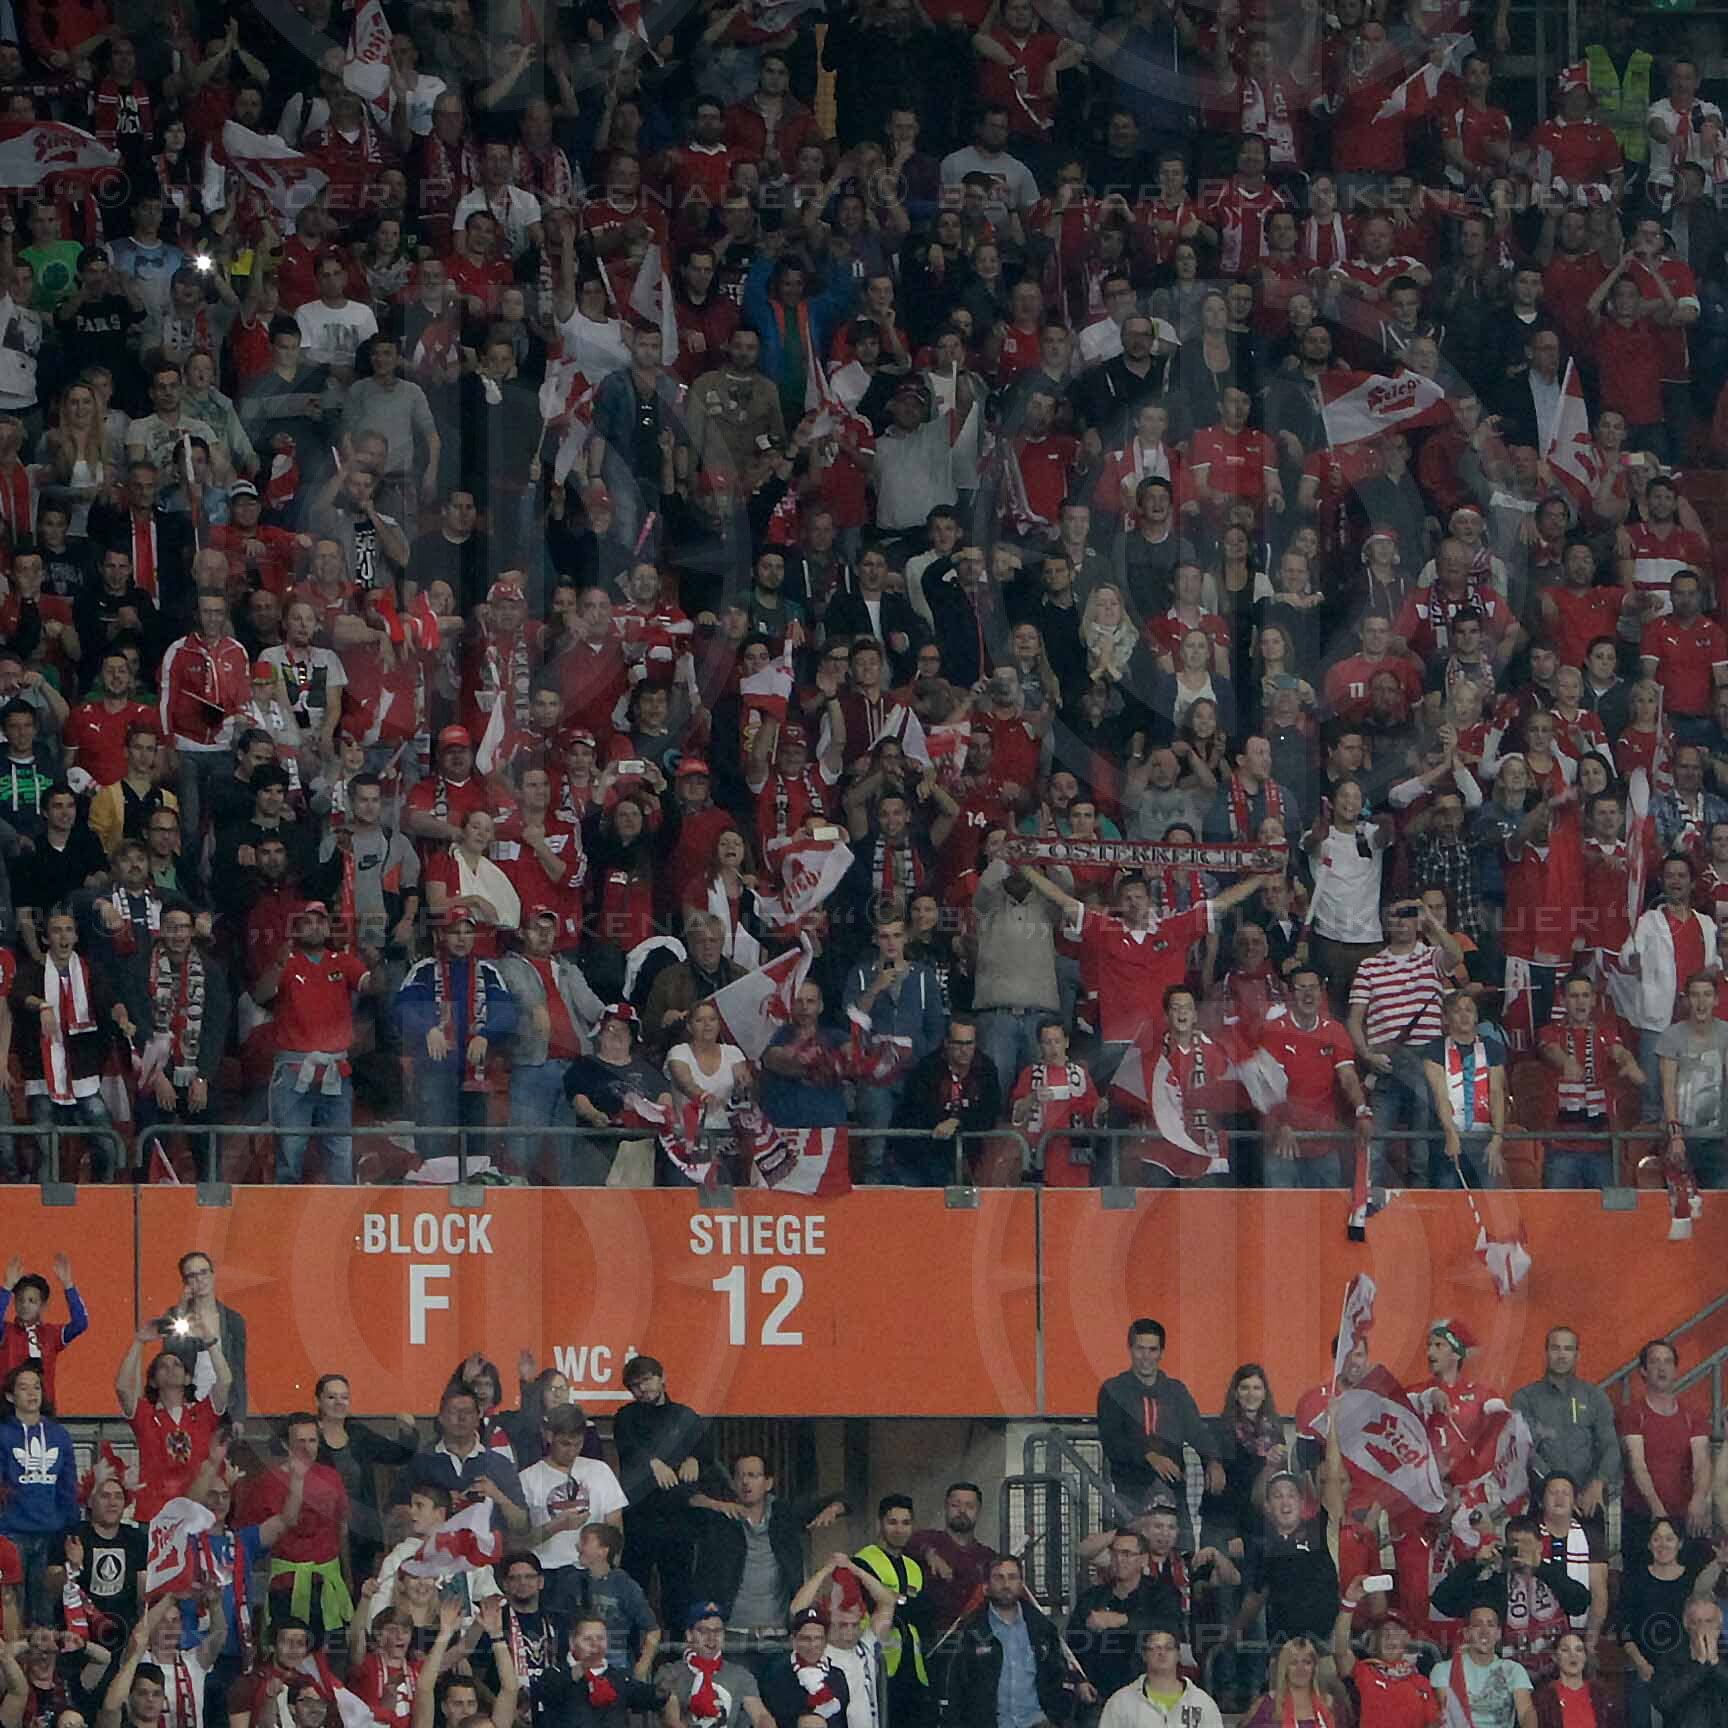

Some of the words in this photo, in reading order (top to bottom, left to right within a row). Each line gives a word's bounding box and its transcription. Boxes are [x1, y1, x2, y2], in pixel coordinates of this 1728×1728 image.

[363, 1213, 493, 1255] BLOCK
[689, 1214, 826, 1256] STIEGE
[409, 1265, 451, 1345] F
[712, 1265, 804, 1347] 12
[554, 1346, 612, 1383] WC
